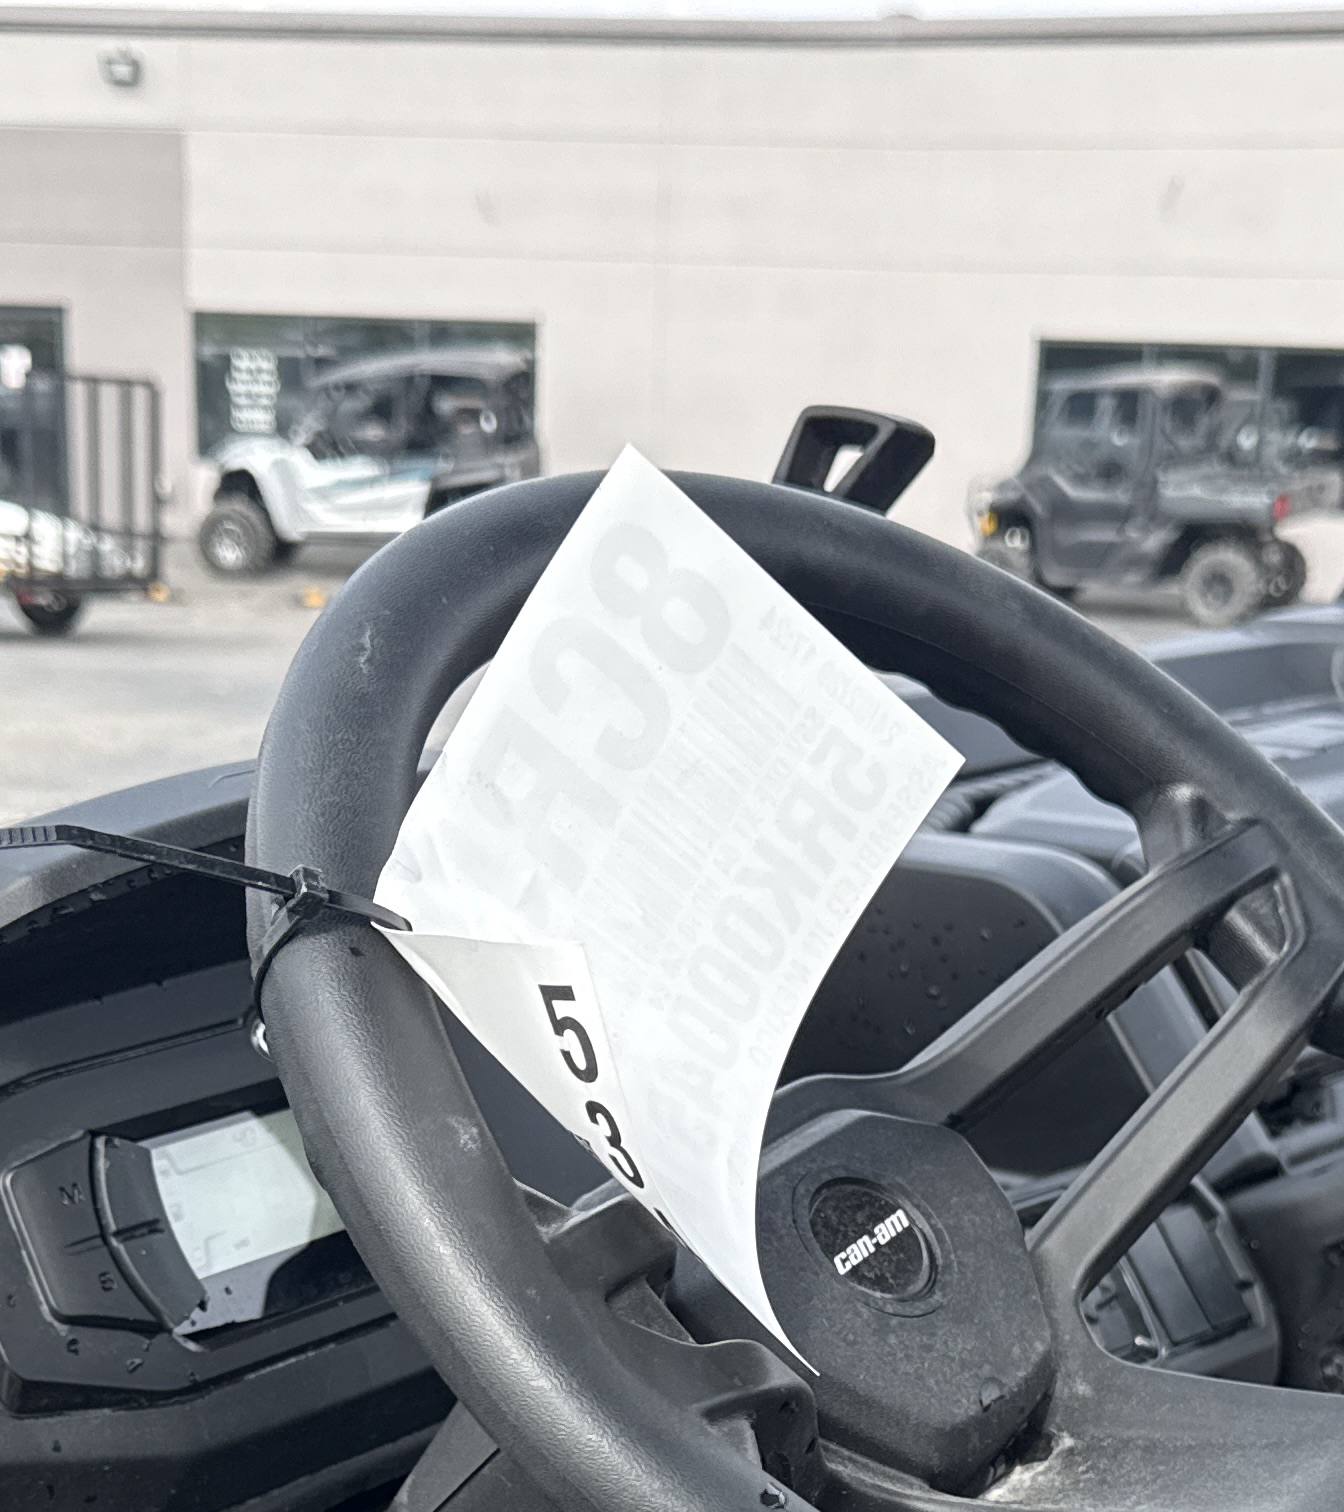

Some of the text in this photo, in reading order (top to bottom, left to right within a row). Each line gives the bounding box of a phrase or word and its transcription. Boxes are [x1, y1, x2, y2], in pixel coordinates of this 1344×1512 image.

[538, 984, 598, 1083] 5
[585, 1100, 644, 1189] 3
[834, 1209, 910, 1275] can-am
